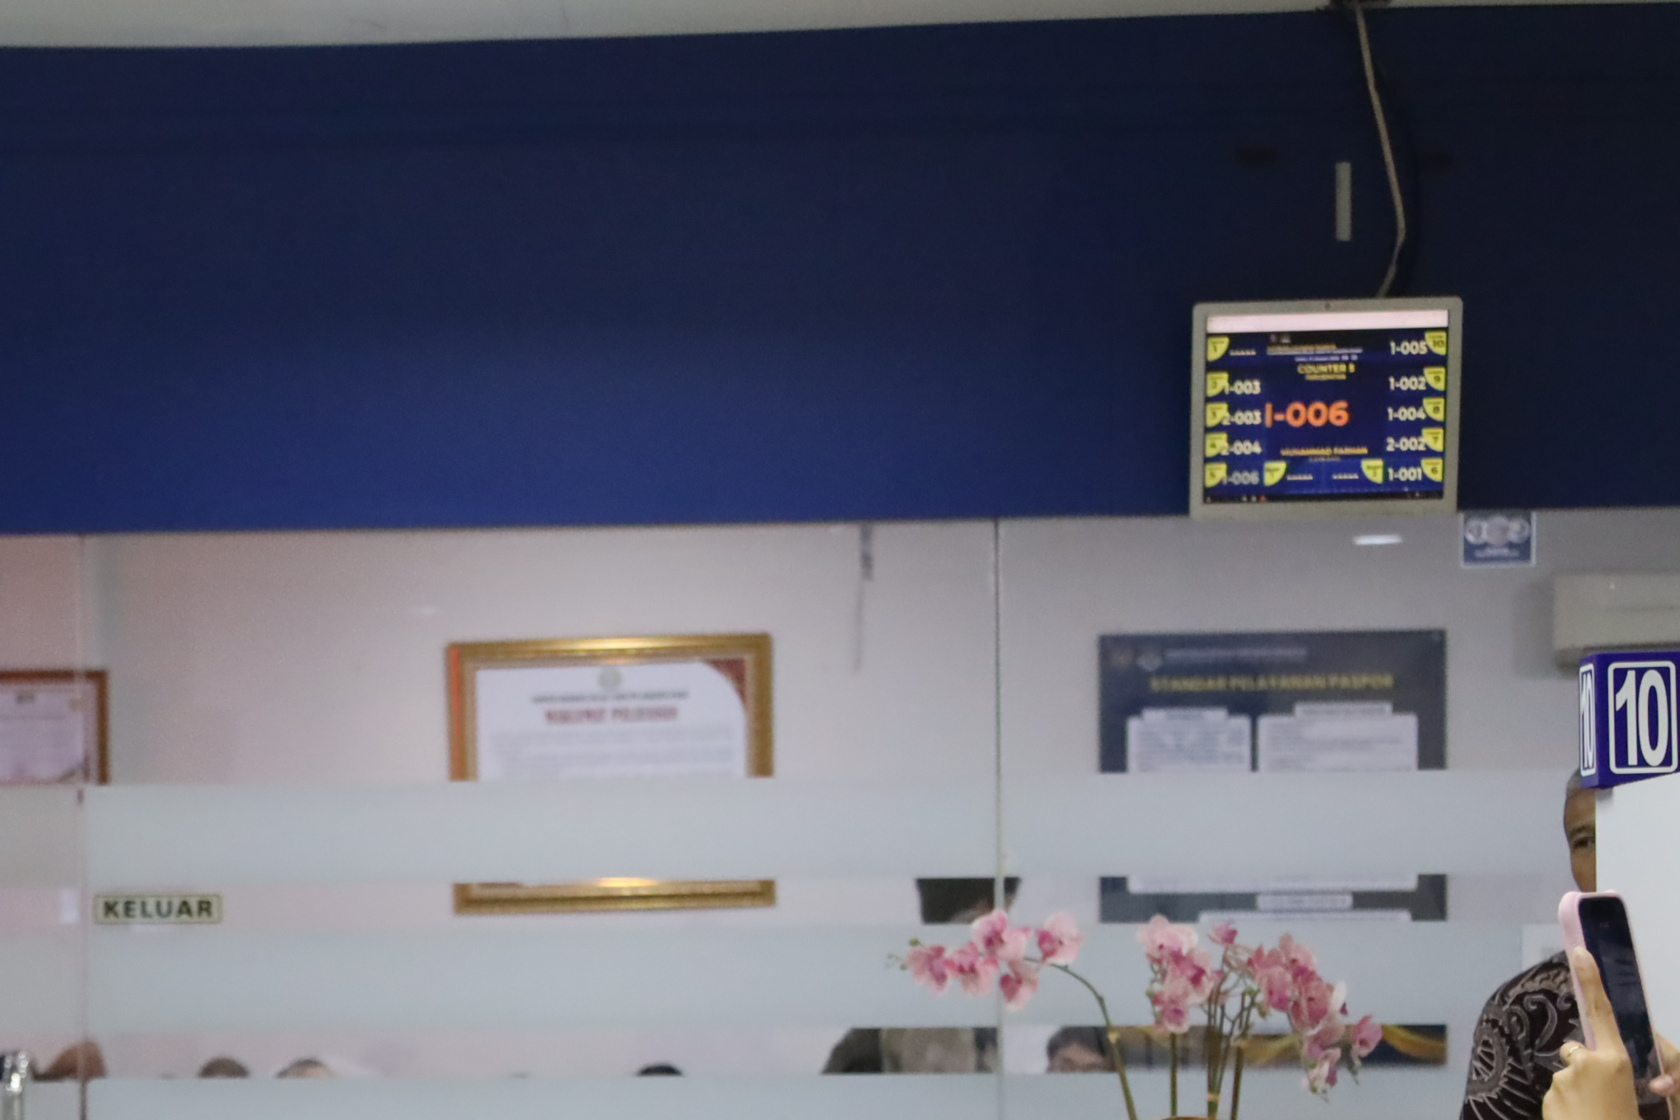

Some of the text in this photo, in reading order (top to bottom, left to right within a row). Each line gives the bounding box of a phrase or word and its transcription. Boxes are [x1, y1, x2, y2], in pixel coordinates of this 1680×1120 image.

[1390, 340, 1428, 355] 1-005
[1297, 363, 1346, 374] COUNTER
[1389, 376, 1427, 391] 1-002
[1387, 466, 1423, 481] 1-001
[1580, 672, 1595, 769] 10
[1615, 669, 1669, 767] 10
[103, 900, 213, 918] KELUAR
